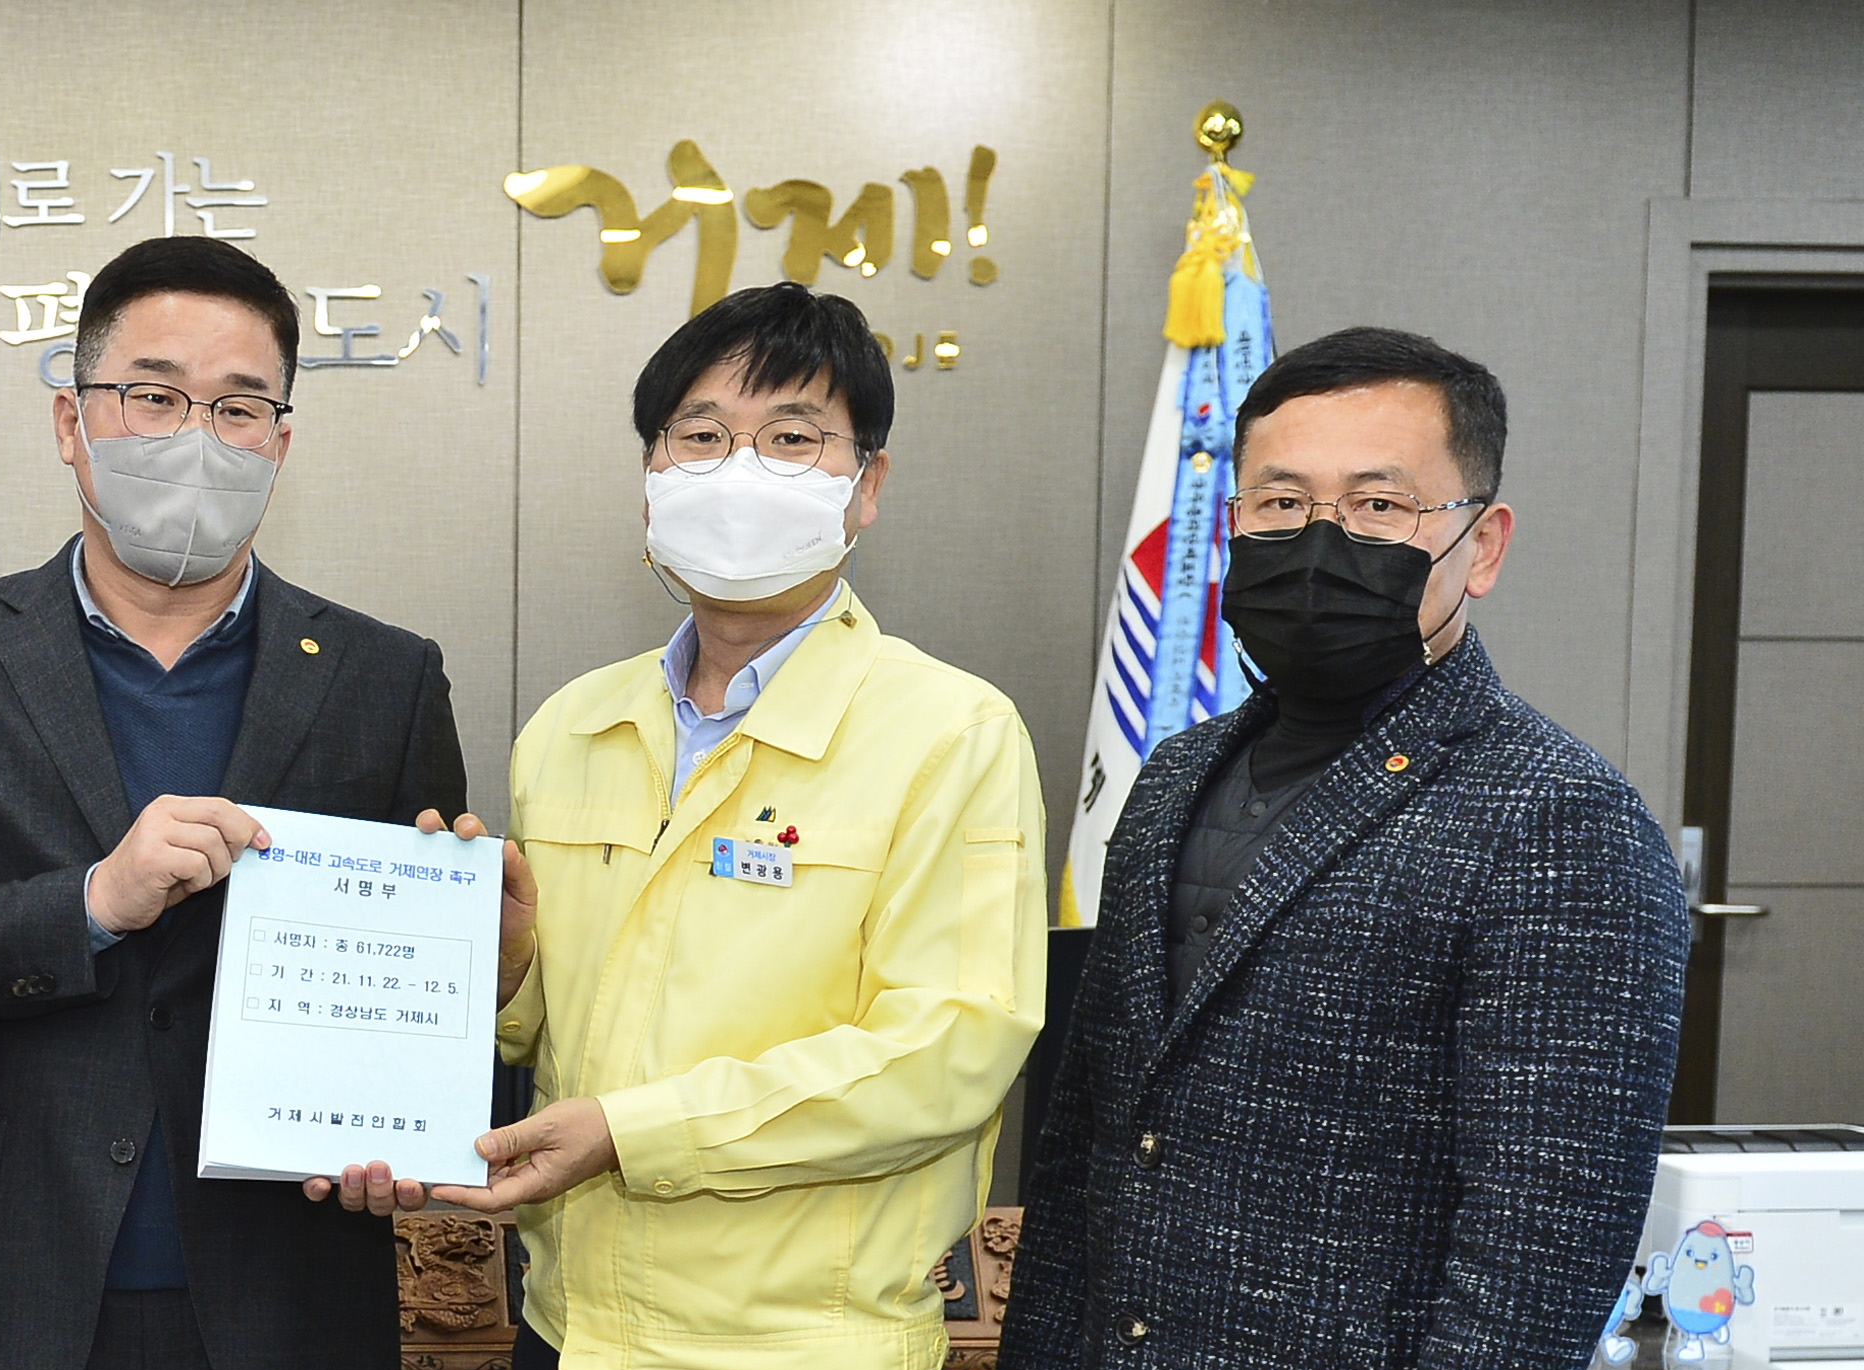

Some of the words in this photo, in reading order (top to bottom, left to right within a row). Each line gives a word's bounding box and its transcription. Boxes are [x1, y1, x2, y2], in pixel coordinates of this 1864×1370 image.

[108, 150, 269, 240] 가는
[298, 272, 490, 385] 도시
[327, 853, 383, 874] 고속도로
[388, 862, 444, 883] 거제연장
[273, 930, 317, 949] 서명자
[355, 940, 416, 960] 61,722명
[329, 1003, 388, 1022] 경상남도
[395, 1008, 440, 1026] 거제시
